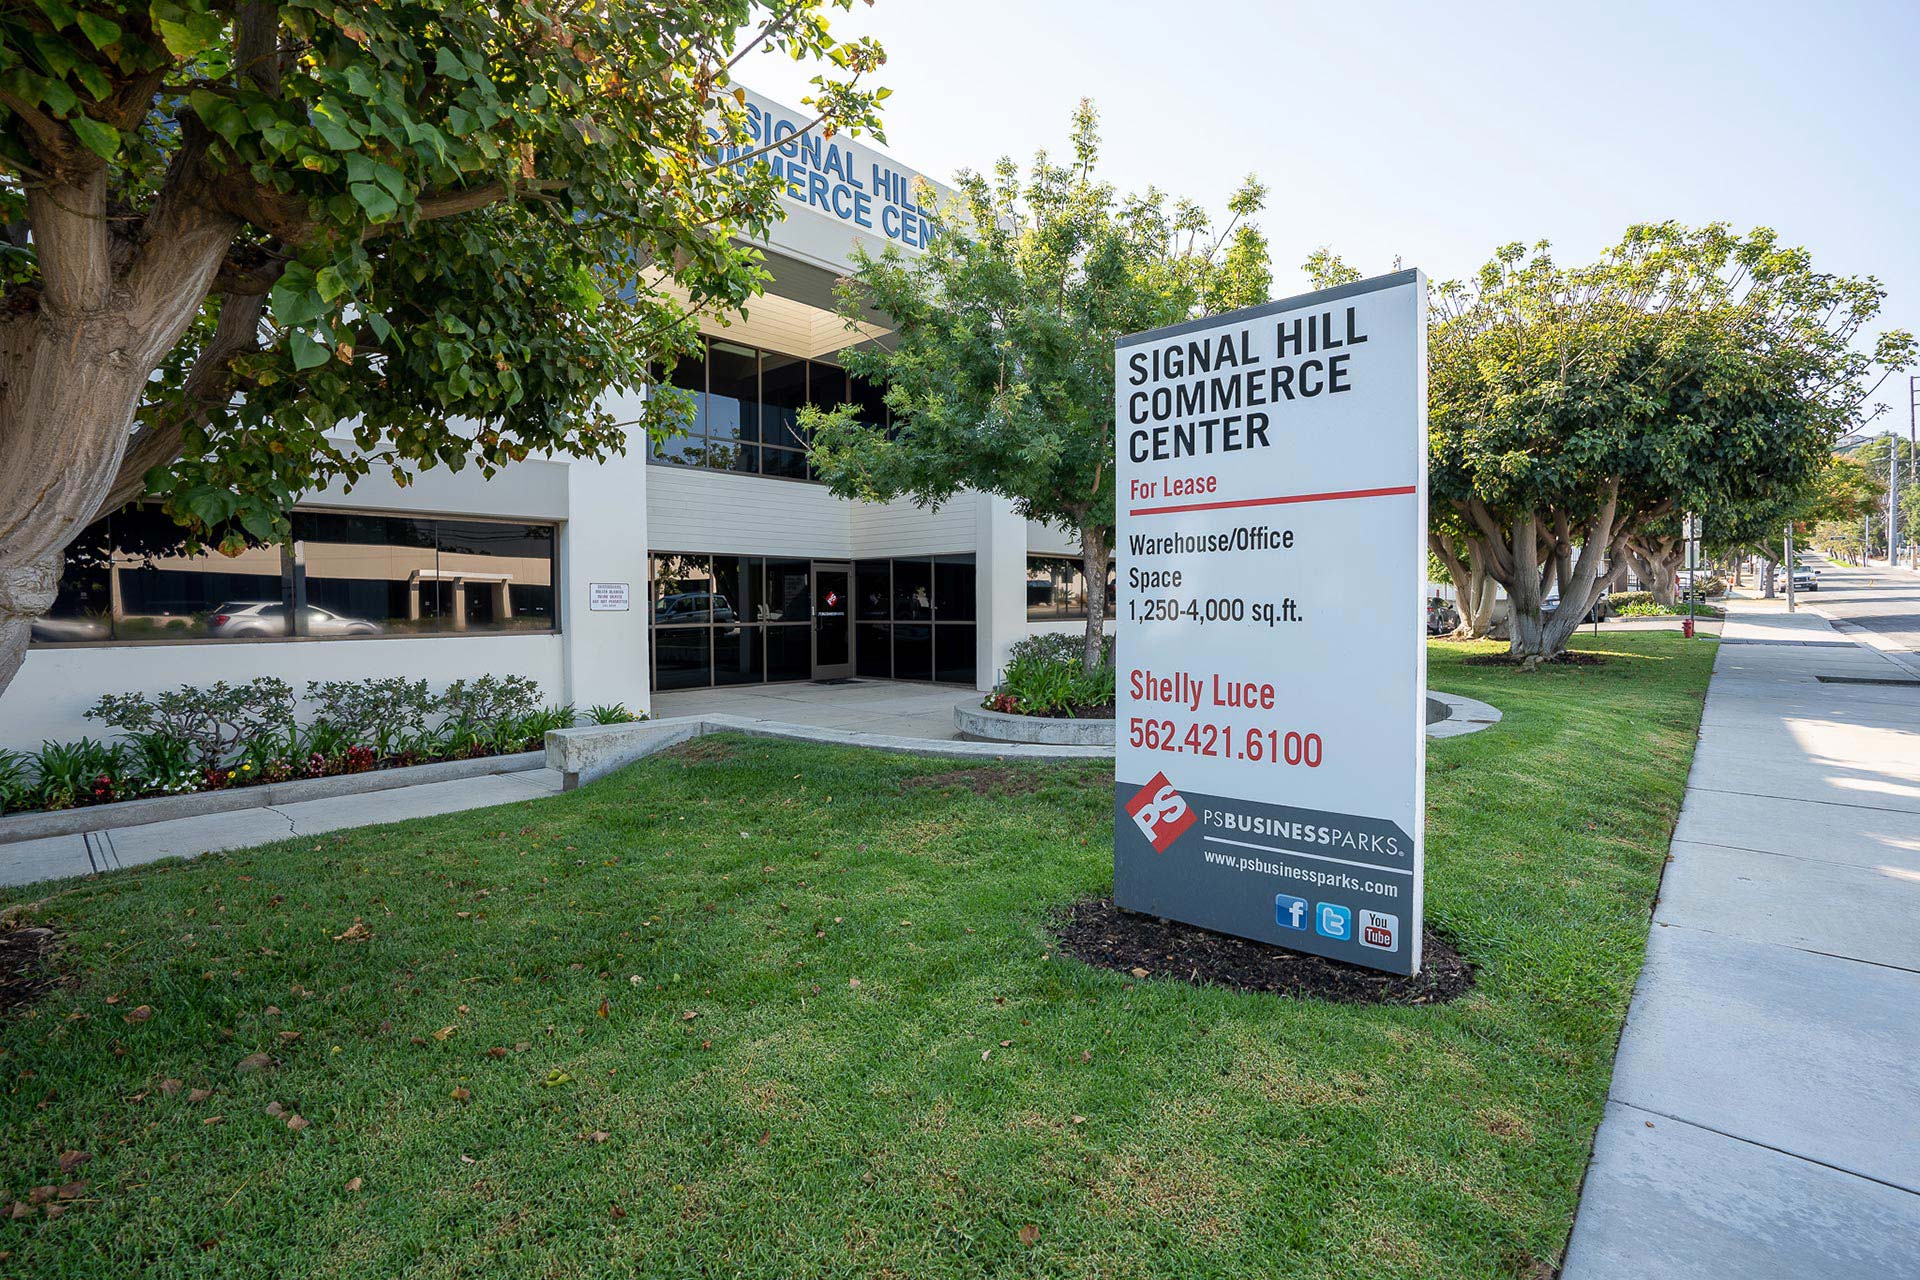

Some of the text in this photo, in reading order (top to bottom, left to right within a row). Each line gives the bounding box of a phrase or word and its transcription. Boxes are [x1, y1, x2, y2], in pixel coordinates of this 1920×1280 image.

[742, 102, 863, 190] SIGNAL
[1128, 306, 1368, 386] SIGNAL HILL
[1129, 353, 1352, 425] COMMERCE
[1129, 412, 1271, 464] CENTER
[1130, 474, 1217, 500] For Lease
[1129, 526, 1294, 556] Warehouse/Office
[1129, 567, 1182, 593] Space
[1128, 598, 1303, 627] 1,250-4,000 sq.ft.
[1129, 669, 1275, 712] Shelly Luce
[1129, 717, 1323, 768] 562.421.6100
[1132, 784, 1188, 843] PS
[1204, 850, 1398, 898] www.psbusinessparks.com
[1366, 928, 1391, 946] Tube
[1369, 913, 1388, 929] You
